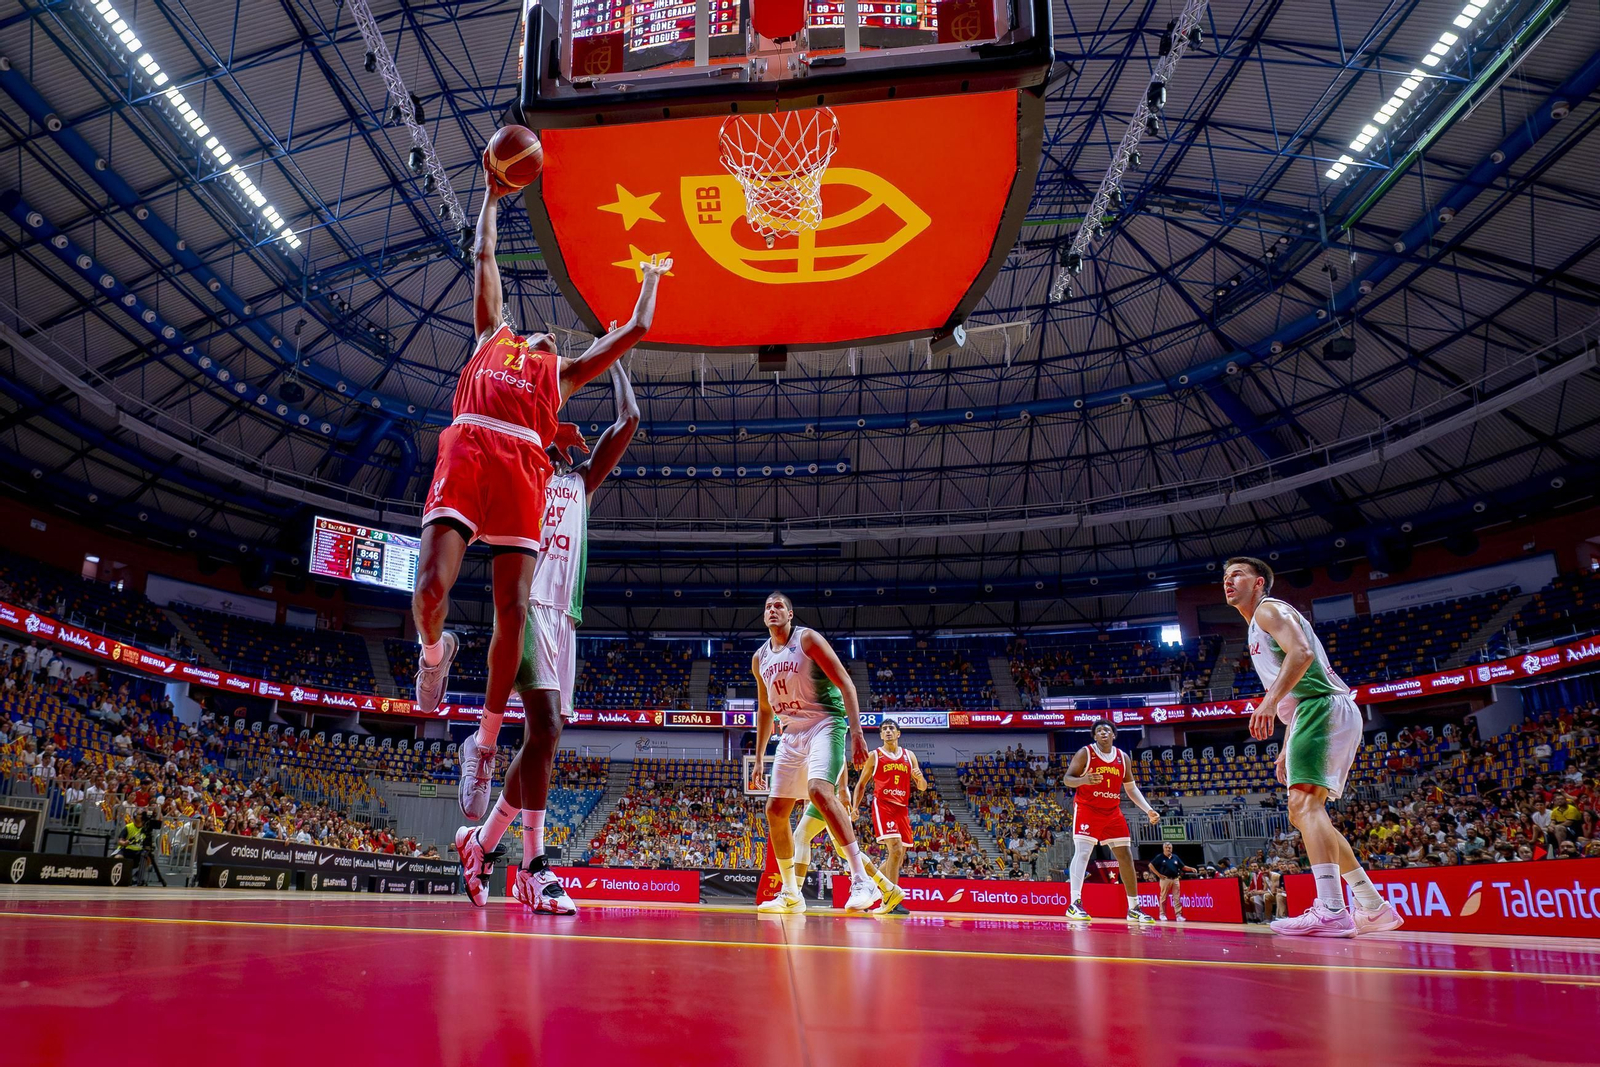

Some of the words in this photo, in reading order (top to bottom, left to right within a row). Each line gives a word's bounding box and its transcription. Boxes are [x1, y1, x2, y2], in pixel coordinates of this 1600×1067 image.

[696, 186, 722, 224] FEB
[373, 531, 383, 540] 28
[360, 549, 379, 560] 8:46
[140, 655, 166, 668] IBERIA
[762, 660, 798, 682] PORTUGAL
[1432, 675, 1464, 686] málaga
[773, 679, 788, 695] 14
[1370, 680, 1421, 694] azulmarino
[323, 694, 357, 708] Andalucía
[1192, 705, 1236, 718] Andalucía
[598, 712, 632, 723] Andalucía
[673, 714, 703, 723] ESPAÑA
[733, 714, 746, 724] 18
[860, 714, 876, 725] 28
[898, 716, 942, 725] PORTUGAL
[1074, 713, 1101, 722] málaga
[883, 763, 908, 774] ESPAÑA
[1096, 766, 1120, 776] ESPAÑA
[894, 775, 900, 785] 5
[1106, 779, 1110, 788] 1
[883, 789, 906, 797] endesa
[231, 845, 259, 858] endesa
[40, 866, 98, 879] #LaFamilia
[558, 877, 582, 889] RIA
[601, 878, 640, 891] Talento
[642, 882, 648, 891] a
[650, 880, 680, 892] bordo
[724, 874, 756, 884] endesa
[904, 888, 944, 901] ERIA
[970, 890, 1018, 904] Talento
[1021, 894, 1028, 904] a
[1031, 892, 1067, 906] bordo
[1137, 895, 1160, 908] BERIA
[1196, 893, 1214, 908] bordo
